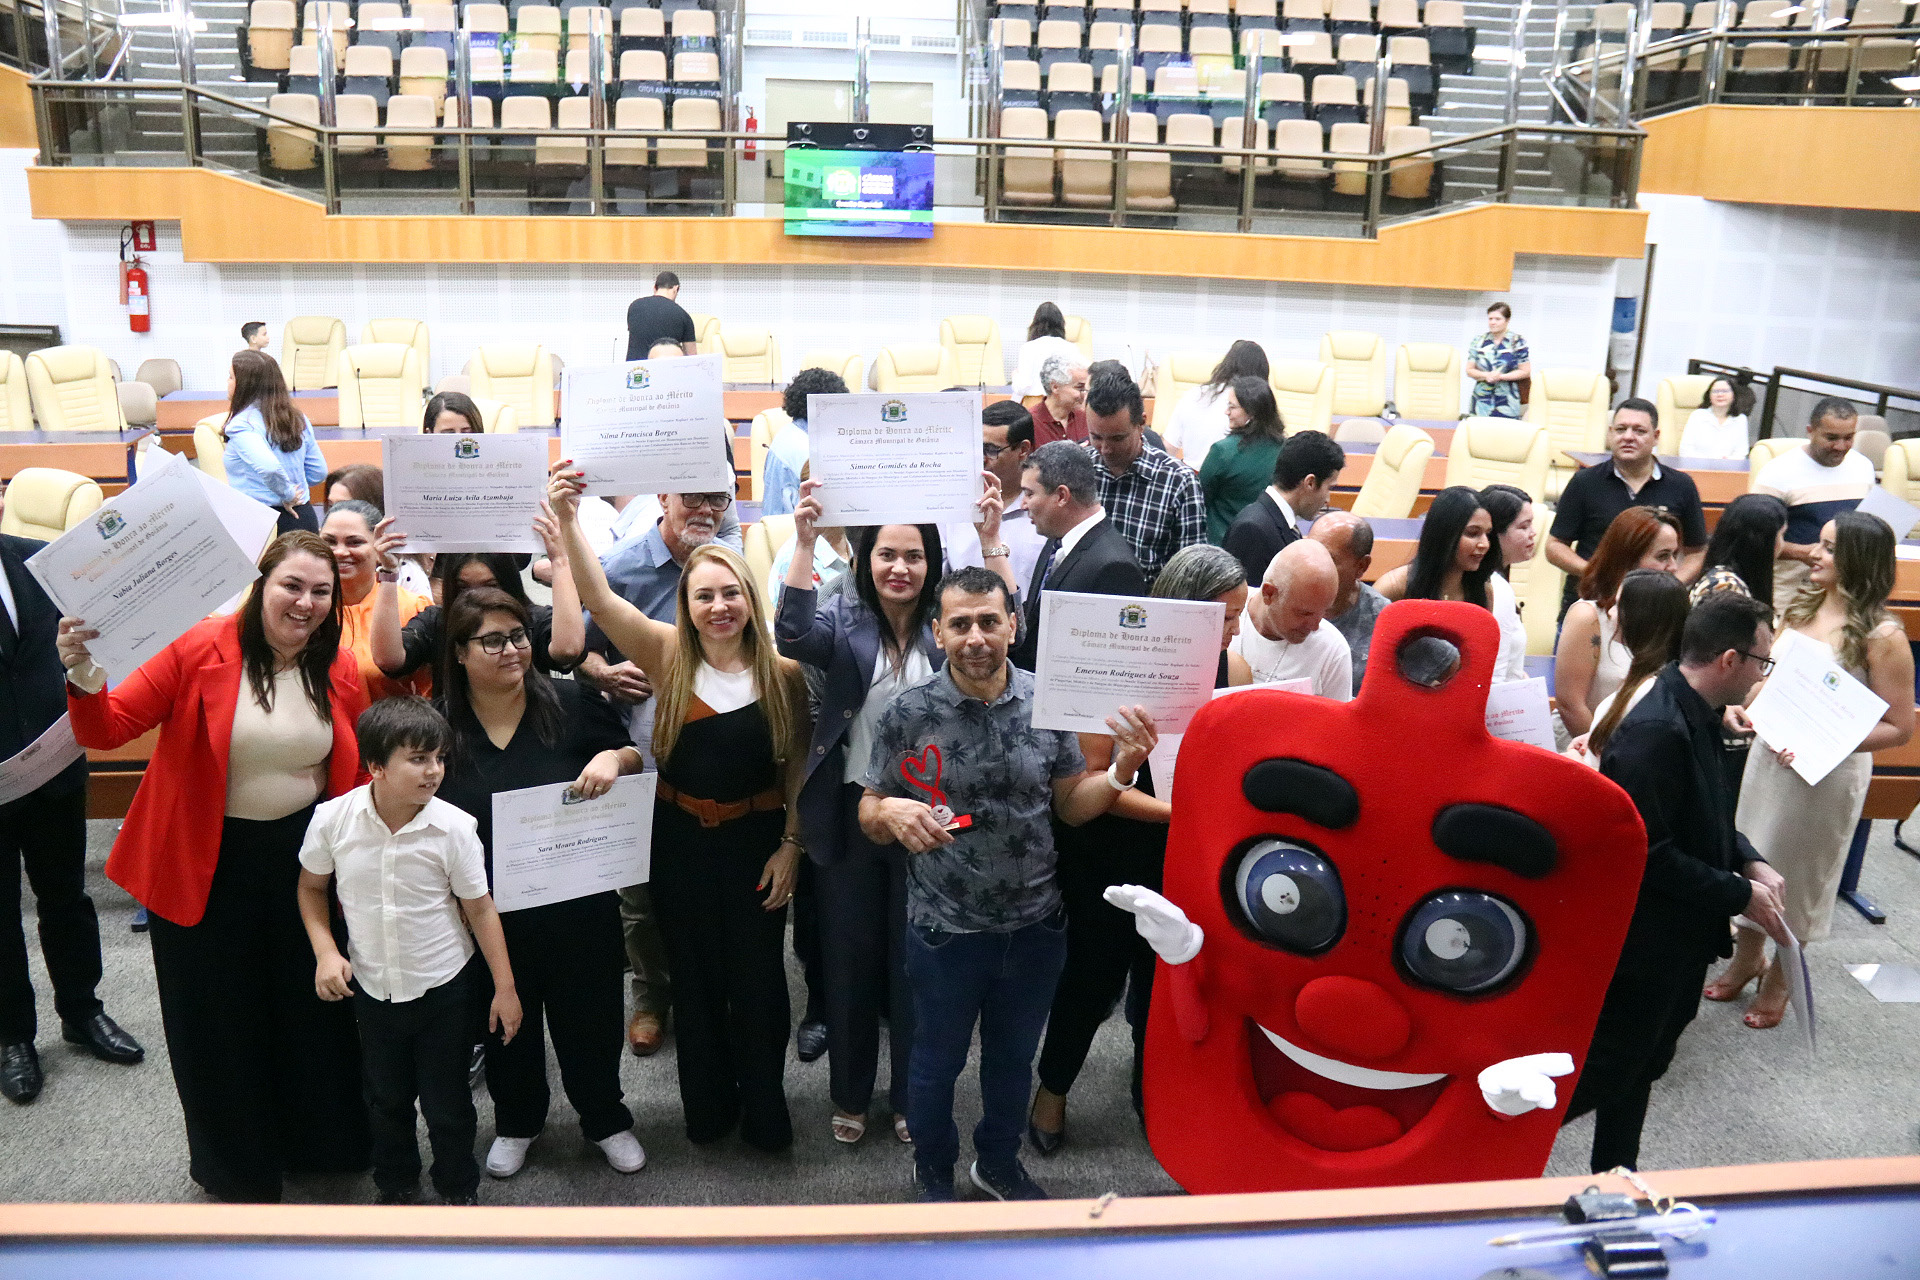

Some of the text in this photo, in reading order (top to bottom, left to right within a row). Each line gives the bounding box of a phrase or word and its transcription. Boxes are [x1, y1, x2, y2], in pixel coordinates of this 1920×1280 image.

[666, 390, 694, 400] Mérito
[620, 430, 653, 438] Francisca
[838, 428, 872, 436] Diploma
[886, 426, 912, 434] Honra
[132, 567, 156, 588] Juliana
[156, 551, 178, 570] Borges
[1070, 628, 1107, 640] Diploma
[1110, 632, 1118, 640] de
[1122, 632, 1148, 642] Honra
[1163, 634, 1192, 644] Mérito
[1081, 640, 1107, 649] Câmara
[1108, 642, 1142, 652] Municipal
[1152, 646, 1177, 654] Goiânia
[1075, 666, 1108, 676] Emerson
[1110, 670, 1147, 680] Rodrigues
[1158, 672, 1180, 680] Souza
[538, 835, 608, 854] Sara Moura Rodrigues
